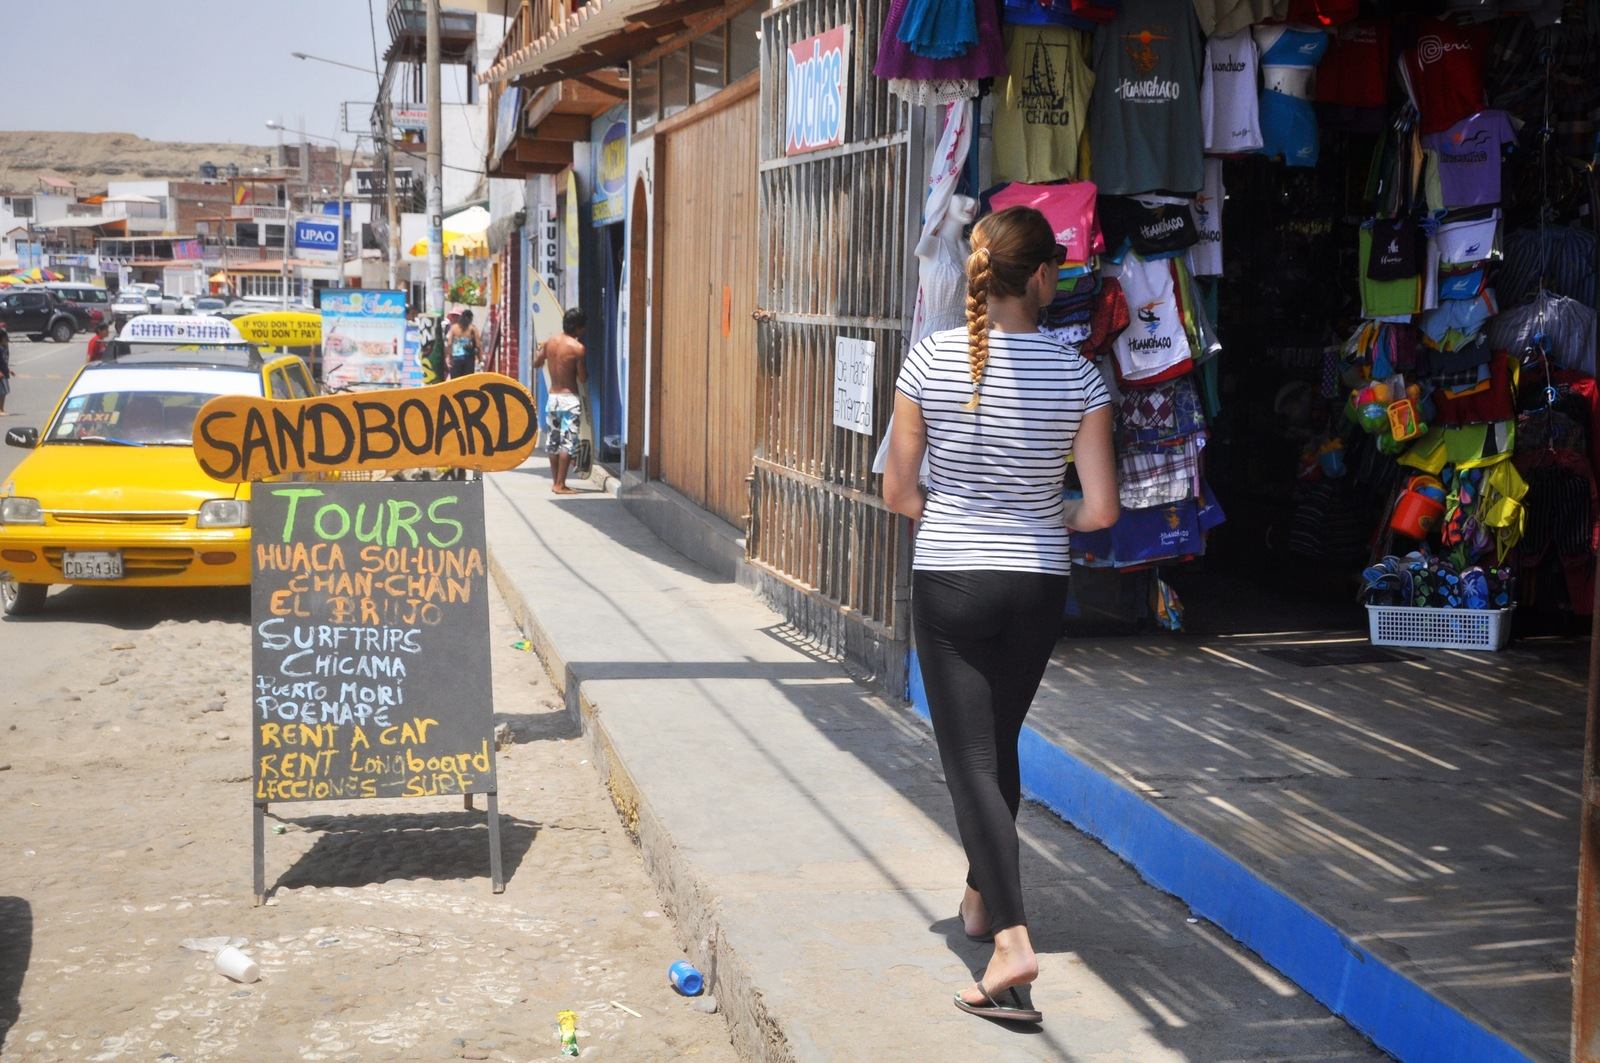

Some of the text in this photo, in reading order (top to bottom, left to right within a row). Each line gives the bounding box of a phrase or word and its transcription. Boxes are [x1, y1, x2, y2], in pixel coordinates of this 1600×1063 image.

[786, 38, 842, 152] Duchas
[1025, 110, 1069, 126] CHACO
[300, 229, 335, 242] UPAO
[251, 330, 269, 338] YOU
[300, 330, 316, 338] PAY
[253, 321, 268, 329] YOU
[297, 321, 322, 329] STAND
[200, 383, 539, 480] SANDBOARD
[271, 488, 464, 549] TOURS
[256, 542, 346, 572] HUACA
[288, 571, 471, 604] CHAN-CHAN
[270, 589, 443, 625] EL BRUJO
[280, 649, 406, 679] CHICAMA
[256, 675, 327, 700] PUERTO
[256, 695, 392, 727] POEMAPE
[260, 722, 340, 749] RENT
[350, 724, 370, 750] A
[260, 749, 340, 779] RENT
[402, 773, 474, 798] SURF
